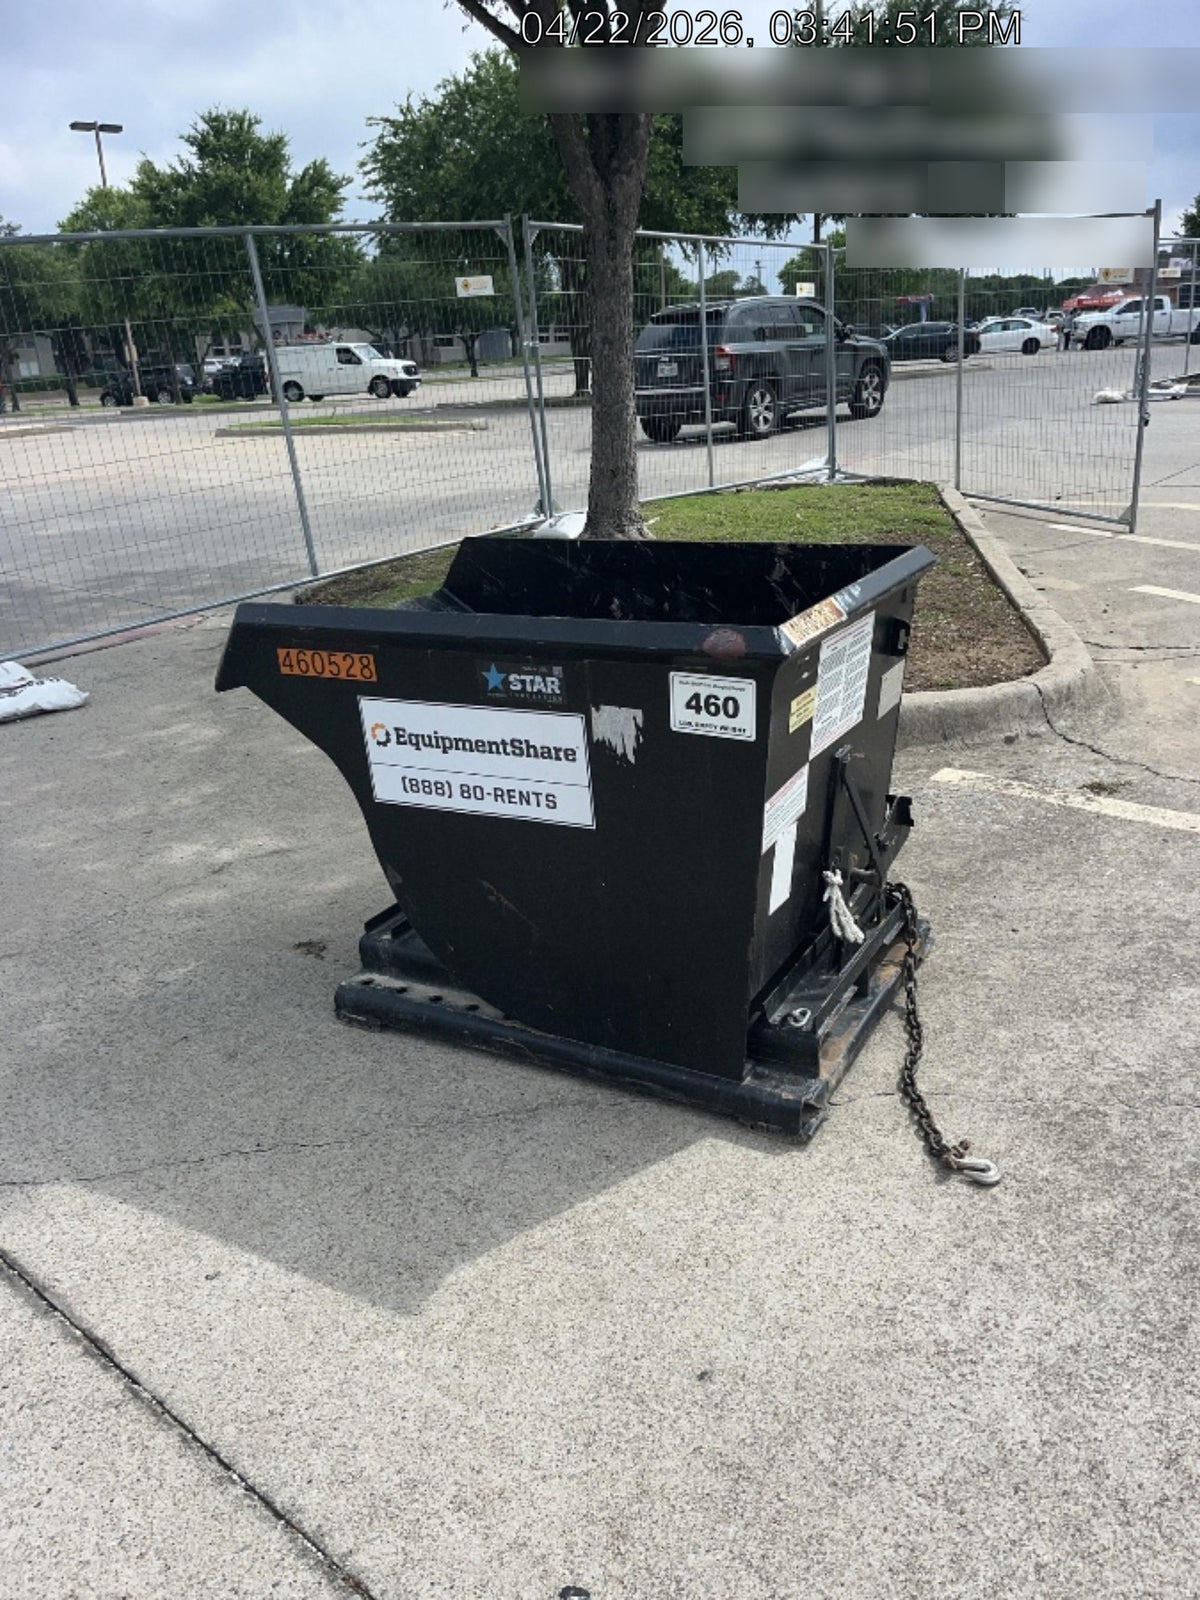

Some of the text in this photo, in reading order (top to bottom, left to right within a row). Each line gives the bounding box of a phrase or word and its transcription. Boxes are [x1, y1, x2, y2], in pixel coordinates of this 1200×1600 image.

[281, 650, 375, 680] 460528
[508, 673, 561, 695] STAR
[685, 691, 740, 719] 460
[393, 726, 577, 763] EquipmentShare
[401, 775, 558, 810] (888) 80-RENTS
